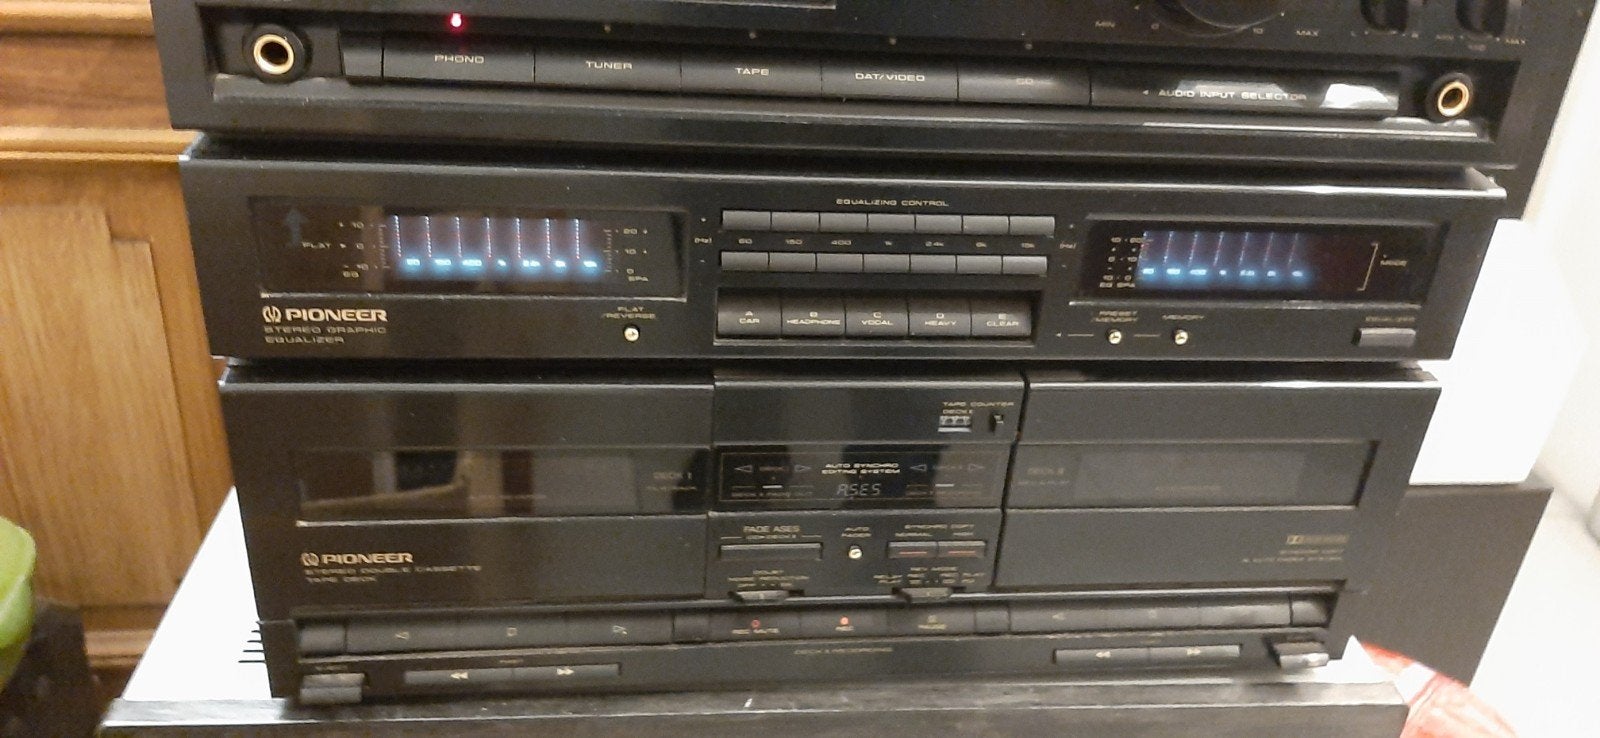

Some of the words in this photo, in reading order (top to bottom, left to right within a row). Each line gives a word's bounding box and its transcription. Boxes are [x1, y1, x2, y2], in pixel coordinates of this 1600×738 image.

[434, 54, 485, 64] PHONO
[585, 60, 633, 70] TUNER
[735, 67, 770, 76] TAPE
[855, 72, 926, 82] DAT/VIDEO
[1158, 89, 1195, 98] AUDIO
[1200, 90, 1236, 99] INPUT
[1240, 91, 1307, 101] SELECTOR
[836, 198, 898, 206] EQUALIZING
[901, 199, 950, 207] CONTROL
[284, 307, 389, 322] PIONEER
[986, 320, 1020, 328] CLEAR
[263, 326, 322, 334] STEREO
[326, 326, 388, 334] GRAPHIC
[264, 336, 345, 344] EQUALIZER
[773, 525, 800, 533] ASES
[321, 552, 414, 564] PIONEER
